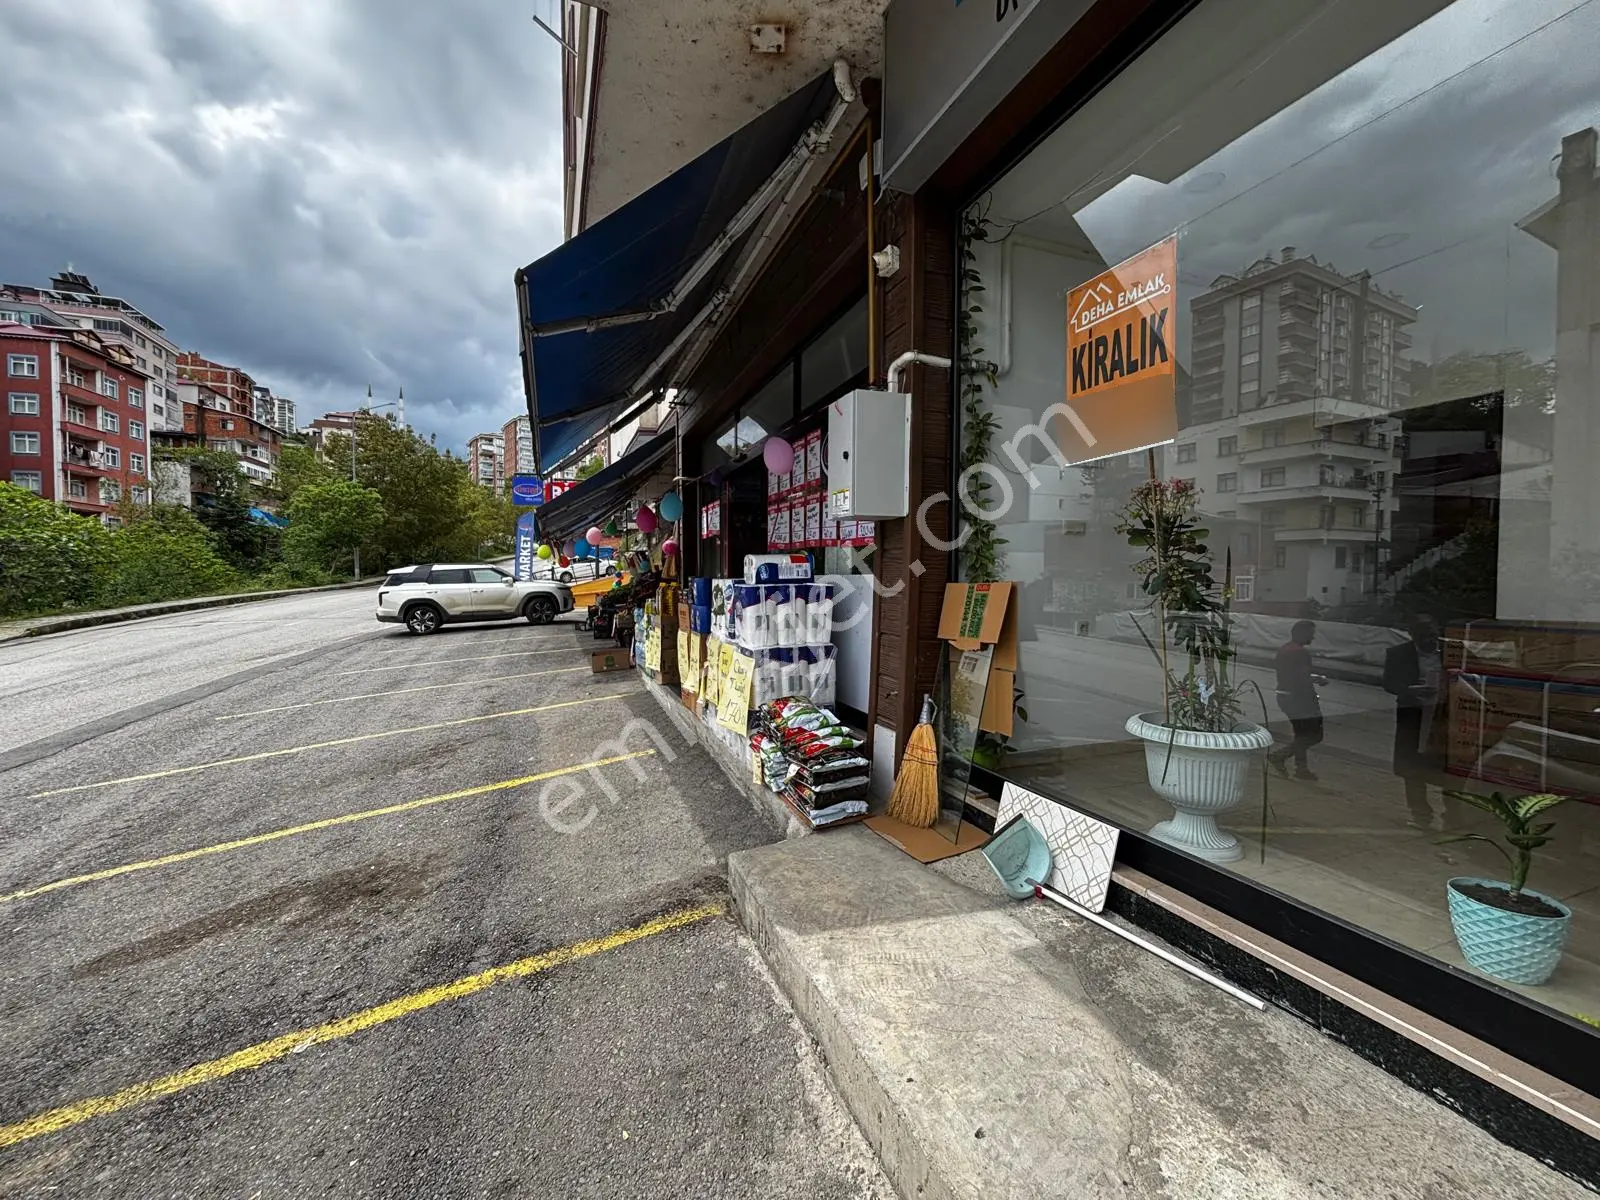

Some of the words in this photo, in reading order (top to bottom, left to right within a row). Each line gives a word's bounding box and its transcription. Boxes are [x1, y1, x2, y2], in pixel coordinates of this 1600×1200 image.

[1081, 299, 1115, 326] DEHA
[1117, 272, 1165, 308] EMLAK
[1071, 306, 1169, 395] KİRALIK
[519, 535, 531, 580] MARKET
